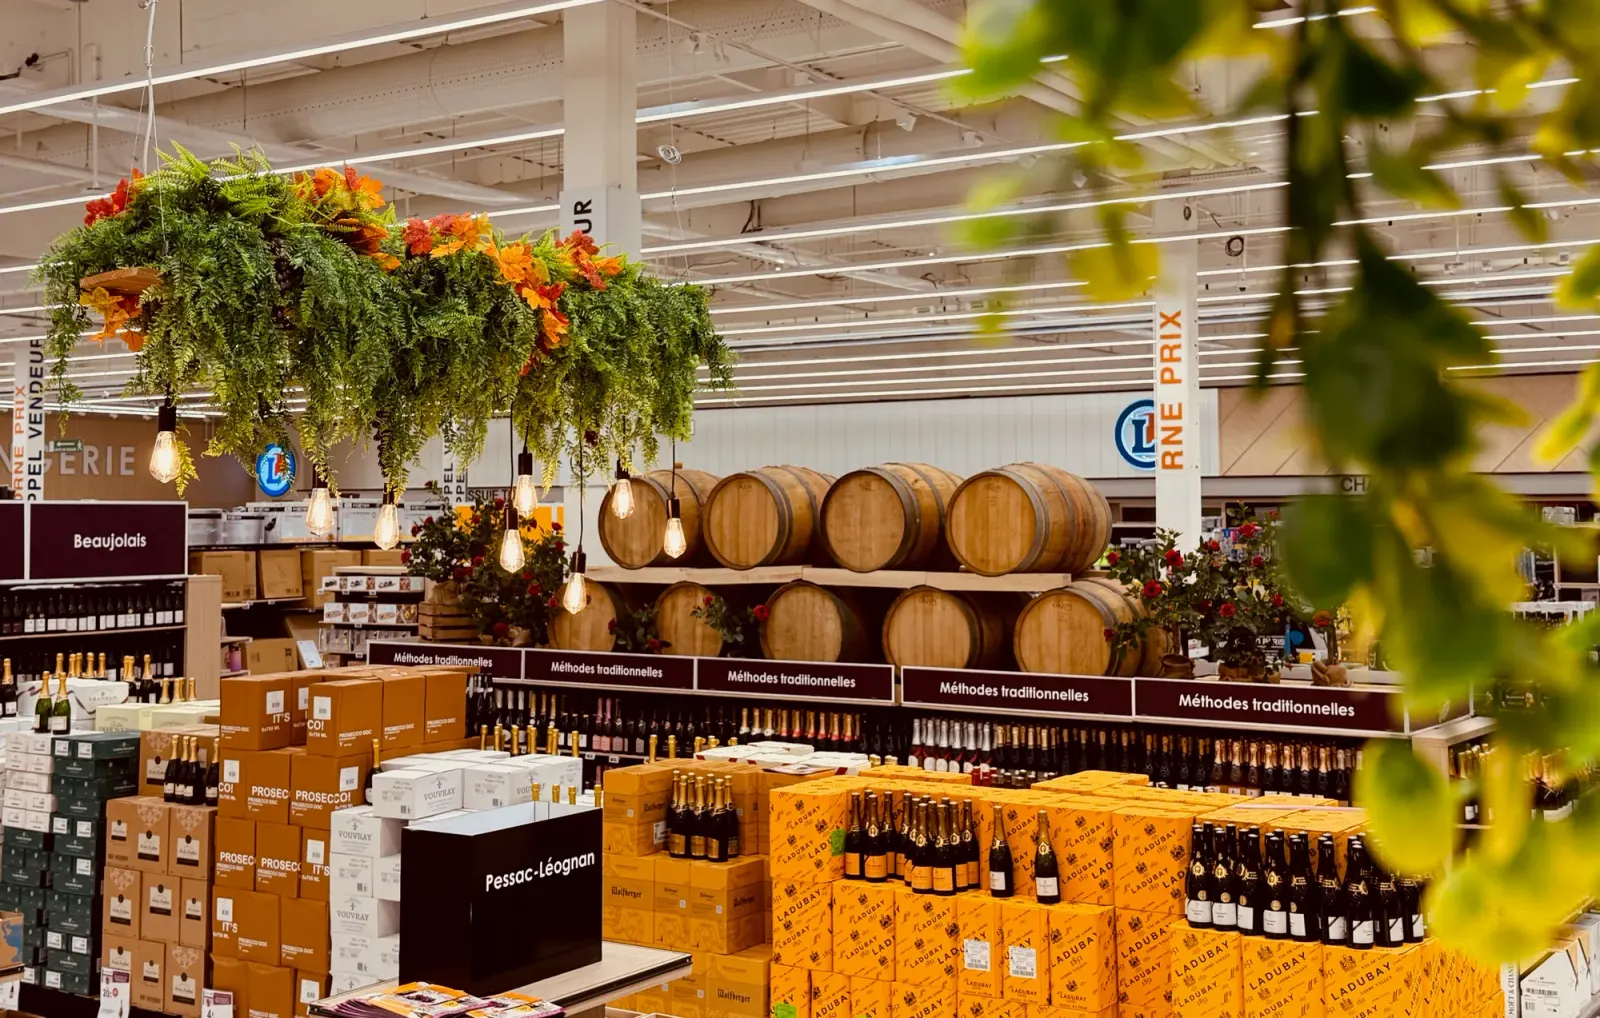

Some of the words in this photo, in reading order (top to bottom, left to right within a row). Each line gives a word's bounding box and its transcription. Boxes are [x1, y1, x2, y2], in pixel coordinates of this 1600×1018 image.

[1160, 310, 1182, 384] PRIX
[14, 386, 26, 434] PRIX
[1160, 402, 1184, 470] RNE
[1341, 478, 1369, 492] CH
[74, 534, 147, 551] Beaujolais
[394, 652, 433, 664] Méthodes
[434, 655, 493, 668] traditionnelles
[550, 661, 595, 675] Méthodes
[597, 664, 663, 678] traditionnelles
[728, 670, 778, 684] Méthodes
[780, 672, 856, 688] traditionnelles
[940, 681, 998, 697] Méthodes
[1001, 684, 1089, 702] traditionnelles
[1178, 693, 1249, 711] Méthodes
[1252, 696, 1355, 717] traditionnelles
[272, 712, 290, 724] IT'S
[308, 720, 324, 730] CO!
[218, 782, 233, 794] CO!
[252, 786, 290, 800] PROSEC
[296, 790, 351, 804] PROSECCO!
[424, 788, 456, 800] VOUVRAY
[790, 804, 820, 829] LADUBAY
[338, 830, 372, 842] VOUVRAY
[1069, 820, 1106, 848] LADUBAY
[1138, 828, 1177, 856] LADUBAY
[220, 852, 256, 866] PROSEC
[782, 840, 814, 864] LADUBAY
[312, 864, 330, 876] IT'S
[486, 852, 596, 892] Pessac-Léognan
[1061, 858, 1098, 884] LADUBAY
[1130, 867, 1168, 894] LADUBAY
[1162, 866, 1189, 888] LAD
[612, 886, 642, 899] Wolfberger
[336, 910, 370, 922] VOUVRAY
[776, 889, 821, 922] LADUBAY
[852, 900, 885, 924] LADUBAY
[222, 922, 238, 933] IT'S
[918, 907, 951, 932] LADUBAY
[779, 925, 810, 948] LADUBAY
[846, 935, 878, 960] LADUBAY
[910, 944, 944, 968] LADUBAY
[1070, 956, 1084, 966] 1851
[1174, 940, 1229, 978] LADUBAY
[1124, 962, 1161, 988] LADUBAY
[1249, 952, 1306, 990] LADUBAY
[1330, 962, 1391, 1001] LADUBAY
[718, 989, 750, 1003] Wolfberger
[1178, 981, 1218, 1008] LADUBAY
